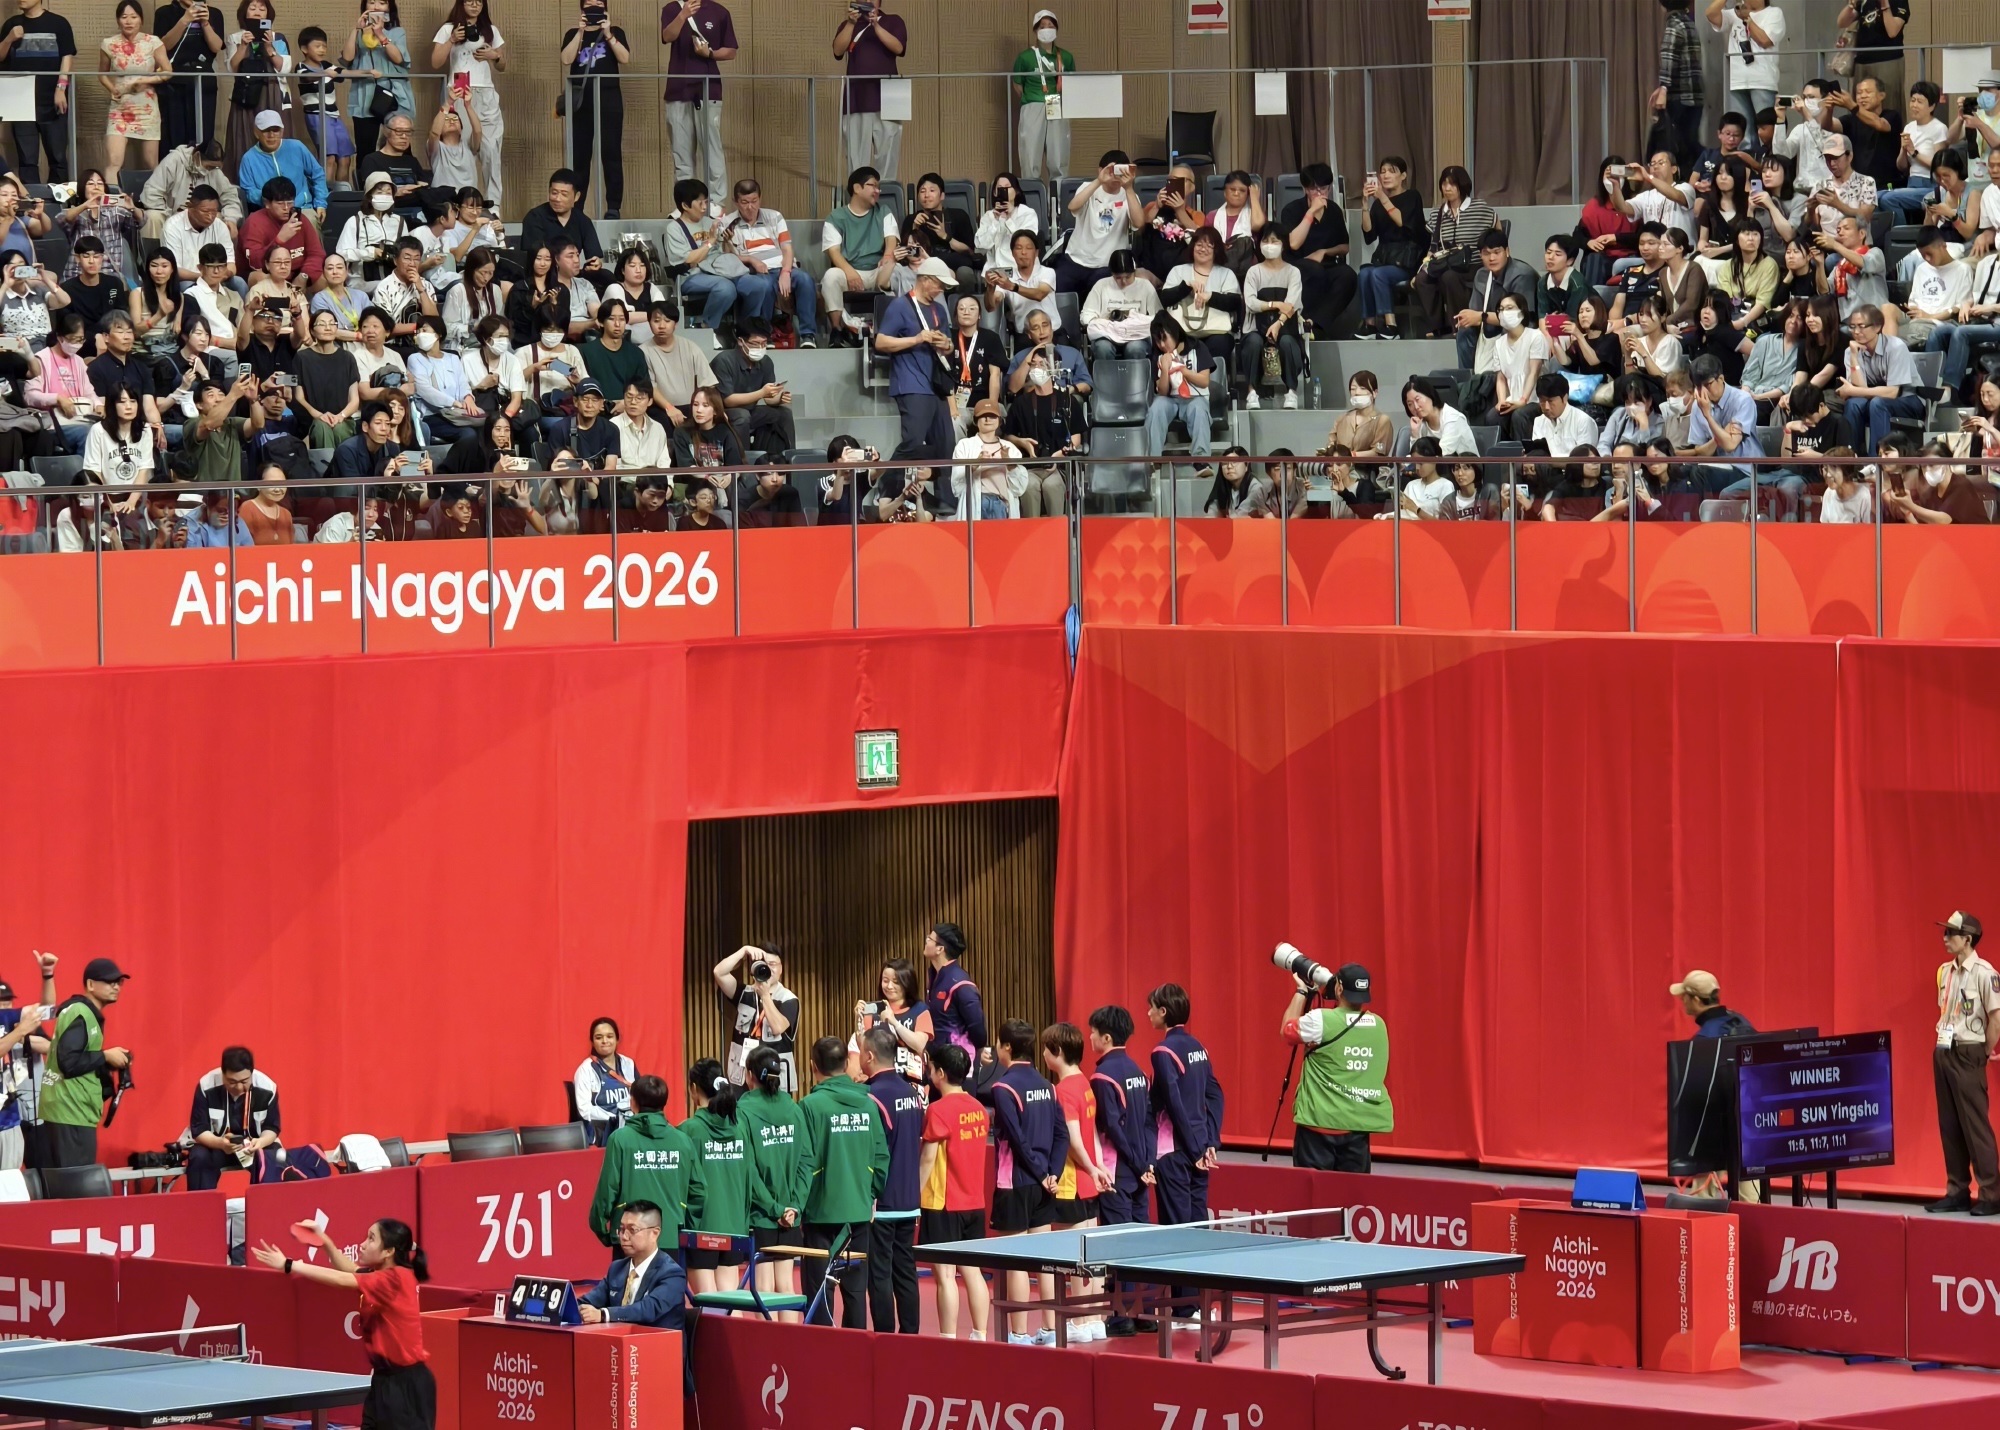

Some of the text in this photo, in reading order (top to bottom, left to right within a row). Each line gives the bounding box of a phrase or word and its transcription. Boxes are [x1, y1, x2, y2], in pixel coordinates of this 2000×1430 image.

[170, 550, 719, 634] Aichi-Nagoya 2026
[1344, 1046, 1373, 1057] POOL
[1346, 1059, 1368, 1070] 303
[1789, 1066, 1841, 1086] WINNER
[606, 1087, 630, 1104] INDI
[1026, 1089, 1051, 1102] CHINA
[959, 1110, 984, 1124] CHINA
[1754, 1100, 1879, 1129] CHN SUN Yingsha
[476, 1179, 573, 1263] 361°
[1390, 1212, 1468, 1247] MUFG
[1552, 1235, 1599, 1256] Aichi-
[1545, 1254, 1606, 1280] Nagoya
[1678, 1227, 1687, 1303] Aichi-Nagoya
[1726, 1223, 1736, 1331] Aichi-Nagoya 2026
[1767, 1237, 1839, 1294] JTB
[512, 1284, 526, 1306] 4
[548, 1288, 562, 1310] 9
[1556, 1280, 1596, 1299] 2026
[1932, 1274, 2000, 1316] TOY
[493, 1351, 539, 1375] Aichi-
[487, 1373, 545, 1401] Nagoya
[610, 1345, 618, 1430] Aichi-Nagoya
[628, 1344, 640, 1429] Aichi-Nagoya
[152, 1414, 196, 1424] Aichi-Nagoya
[497, 1400, 536, 1422] 2026
